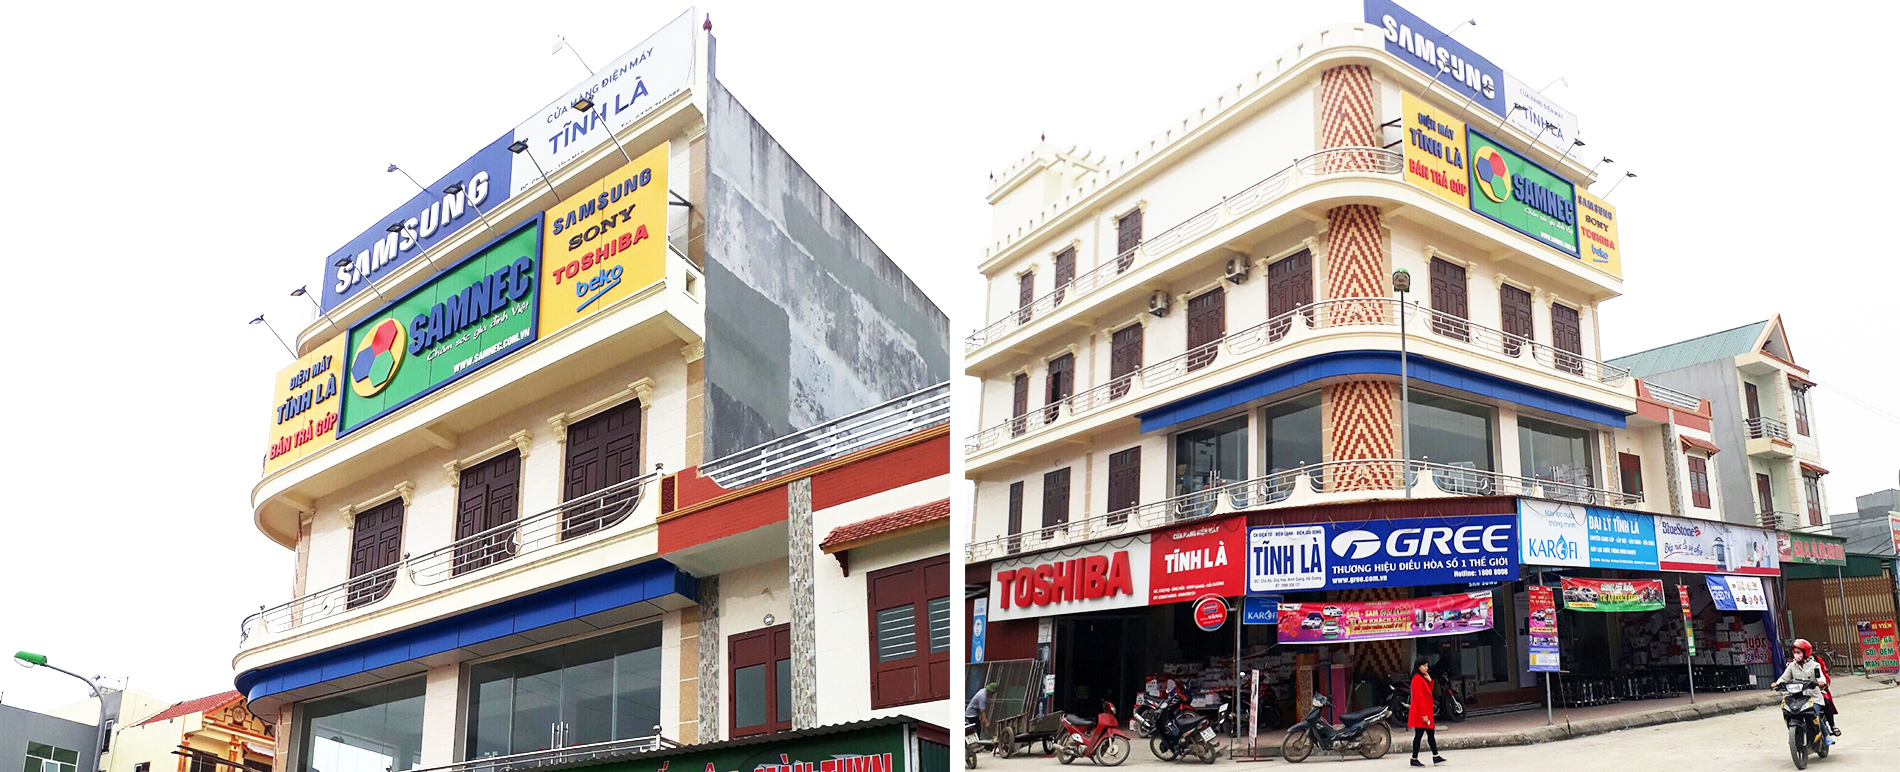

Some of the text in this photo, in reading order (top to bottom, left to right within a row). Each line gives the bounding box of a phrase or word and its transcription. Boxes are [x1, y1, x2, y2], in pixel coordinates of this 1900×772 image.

[1382, 14, 1495, 100] SAMSUNG
[546, 106, 568, 124] CỬA
[601, 64, 628, 89] ĐIỆN
[629, 46, 654, 70] MÁY
[548, 102, 608, 155] TĨNH
[614, 76, 649, 116] LÀ
[1418, 112, 1454, 141] ĐIỆN MÁY
[1522, 106, 1548, 132] TĨNH
[1409, 128, 1464, 170] TĨNH LÀ
[1409, 158, 1430, 180] BÁN
[1430, 169, 1448, 190] TRẢ
[553, 168, 652, 236] SAMSUNG
[1512, 172, 1574, 226] SAMNEC
[1578, 195, 1612, 221] SAMSUNG
[335, 170, 490, 294] SAMSUNG
[568, 204, 636, 252] SONY
[1580, 226, 1616, 250] TOSHIBA
[1585, 215, 1609, 232] SONY
[553, 224, 650, 285] TOSHIBA
[1591, 244, 1608, 260] beko
[576, 264, 624, 298] beko
[408, 256, 534, 356] SAMNEC
[426, 300, 530, 362] Chăm sóc gia đình Việt
[454, 327, 531, 374] WWW.SAMNEC.COM.VN
[289, 355, 332, 391] ĐIỆN MÁY
[276, 372, 336, 426] TĨNH LÀ
[270, 436, 292, 460] BÁN
[294, 419, 313, 448] TRẢ
[1386, 524, 1512, 558] GREE
[1548, 520, 1564, 528] thông
[1588, 515, 1640, 534] ĐẠI LÝ TĨNH LÀ
[1662, 521, 1694, 537] BlueStone
[1164, 540, 1228, 574] TĨNH LÀ
[1254, 537, 1322, 576] TĨNH LÀ
[1332, 556, 1508, 574] THƯƠNG HIỆU ĐIỀU HÒA SỐ 1 THẾ GIỚI
[1528, 534, 1578, 560] KAROFI
[996, 550, 1134, 610] TOSHIBA
[1332, 574, 1388, 584] www.gree.com.vn
